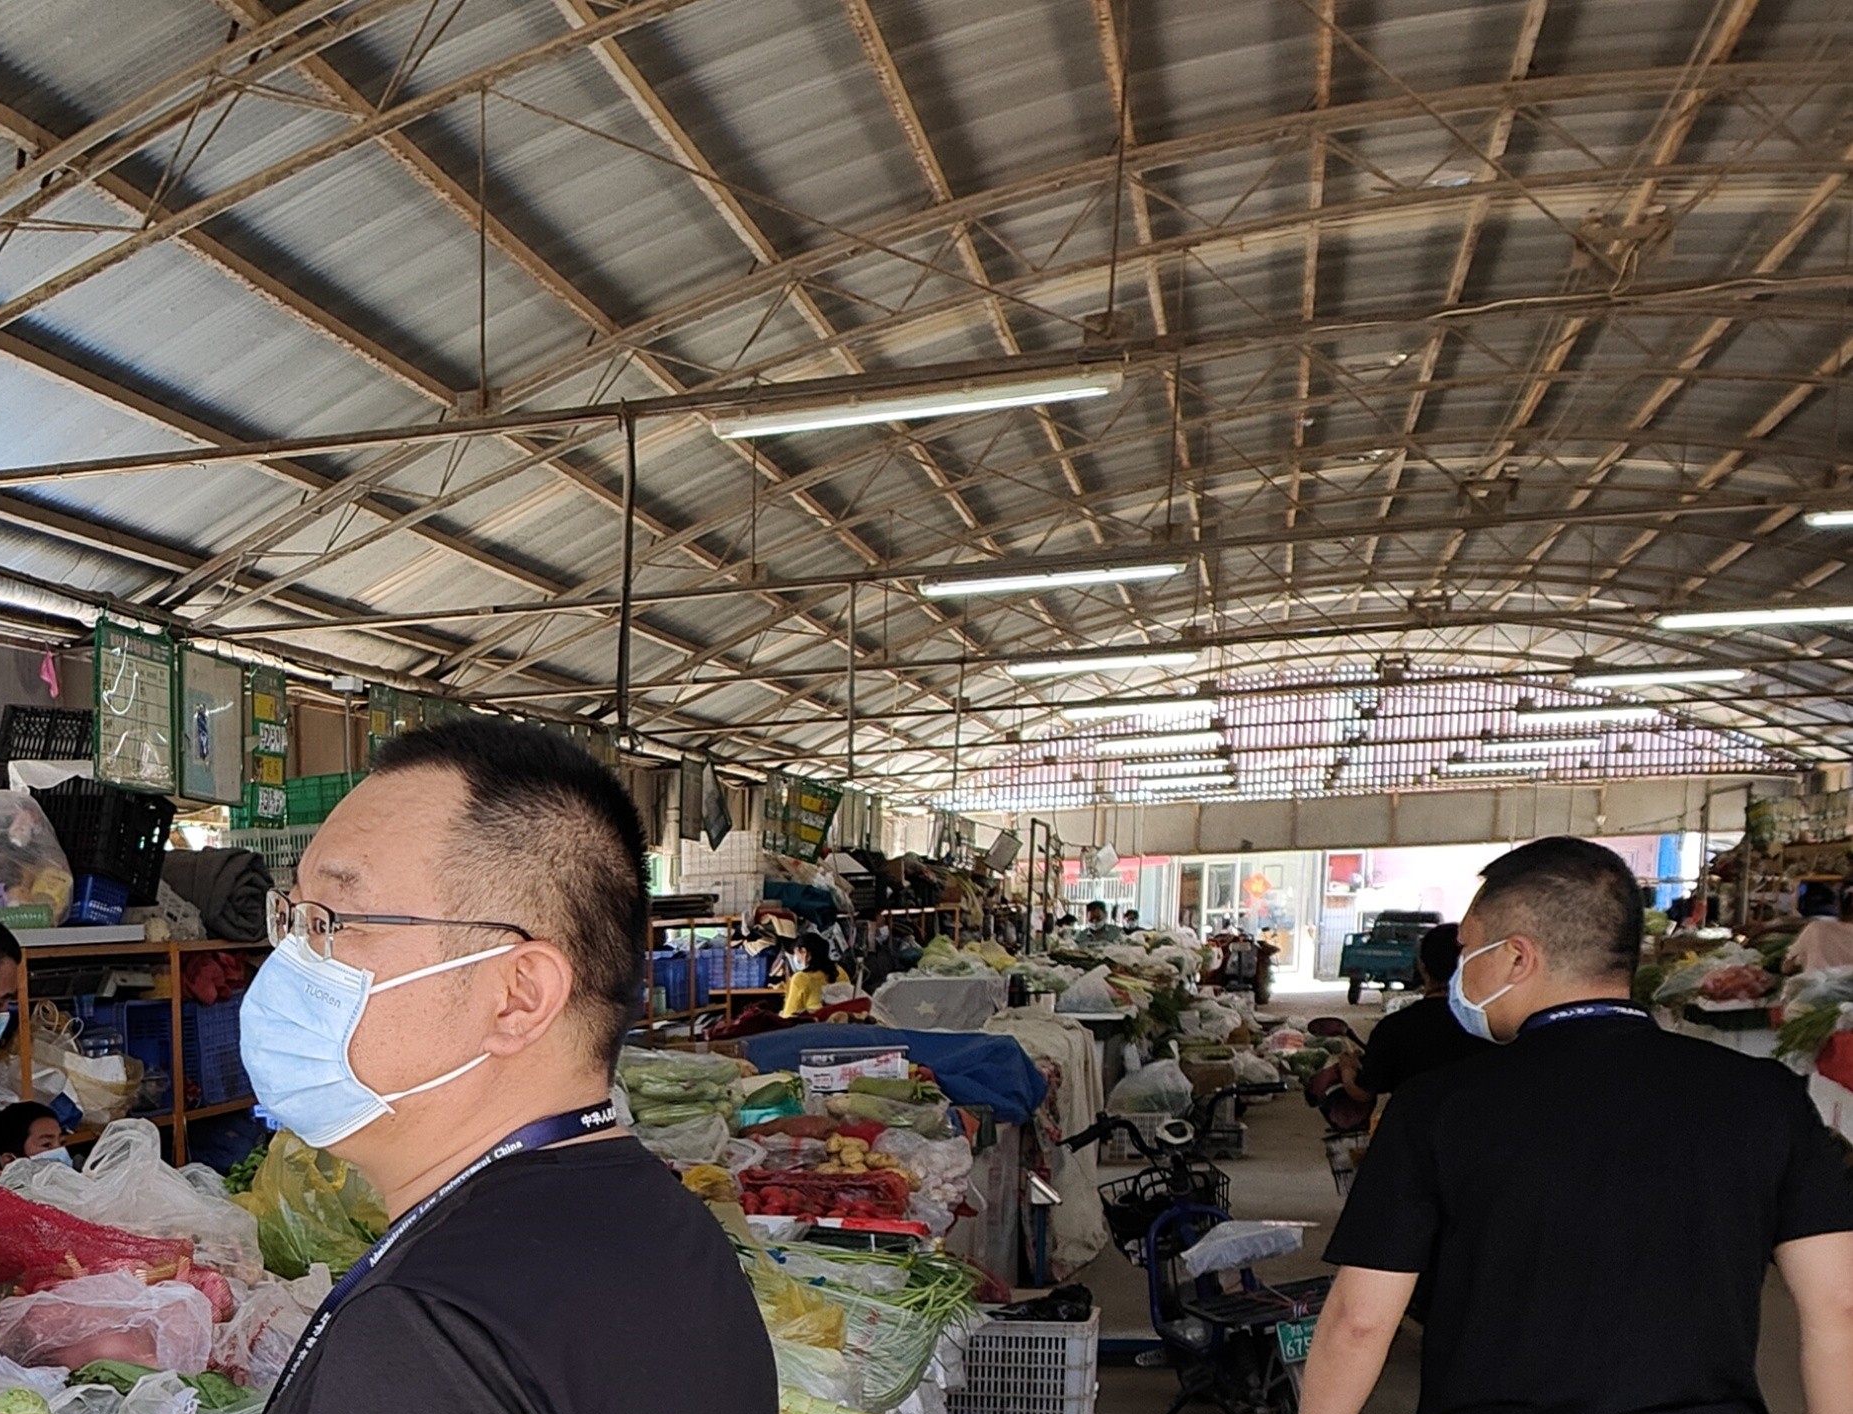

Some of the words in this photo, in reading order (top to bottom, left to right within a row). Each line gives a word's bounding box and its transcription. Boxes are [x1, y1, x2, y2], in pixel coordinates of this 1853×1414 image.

[368, 1212, 418, 1269] Administrative
[419, 1195, 438, 1216] Law
[438, 1154, 493, 1198] Enforcement
[493, 1139, 524, 1161] China
